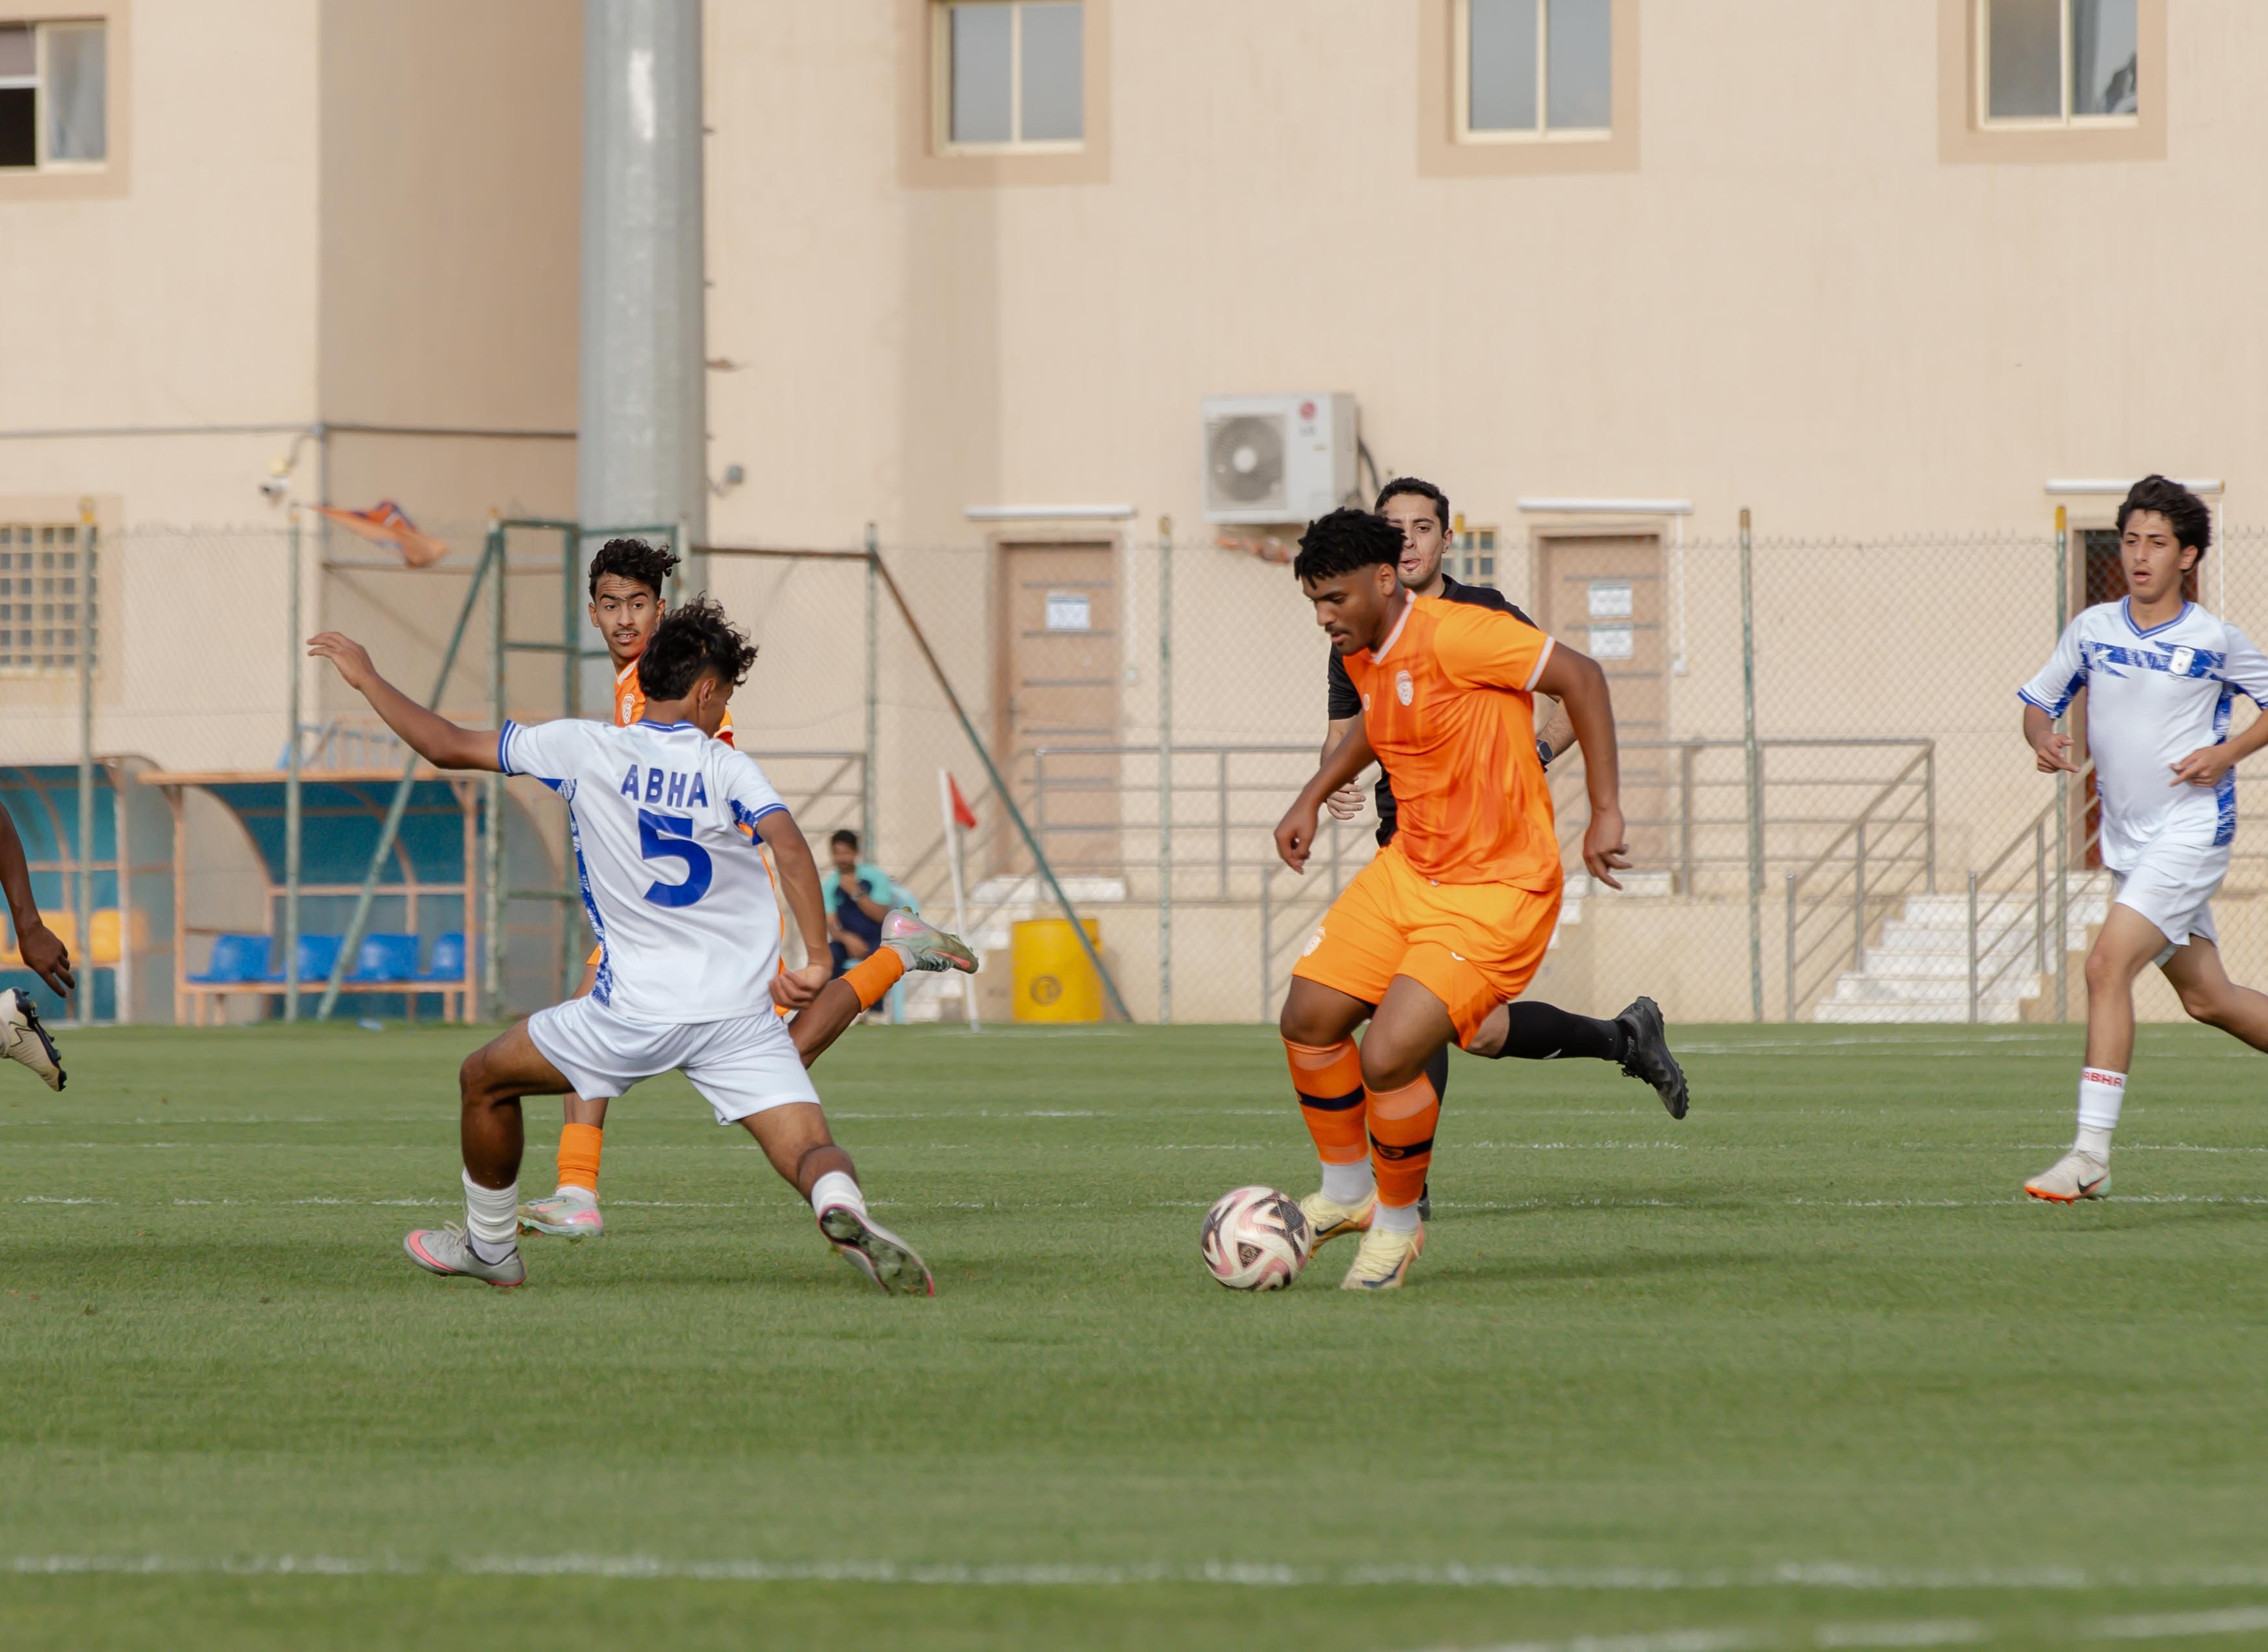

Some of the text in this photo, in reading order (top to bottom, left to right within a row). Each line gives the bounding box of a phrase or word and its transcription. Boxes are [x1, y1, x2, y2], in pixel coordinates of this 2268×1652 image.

[620, 764, 708, 808] ABHA
[638, 808, 712, 908] 5
[2083, 1071, 2122, 1087] ABHA
